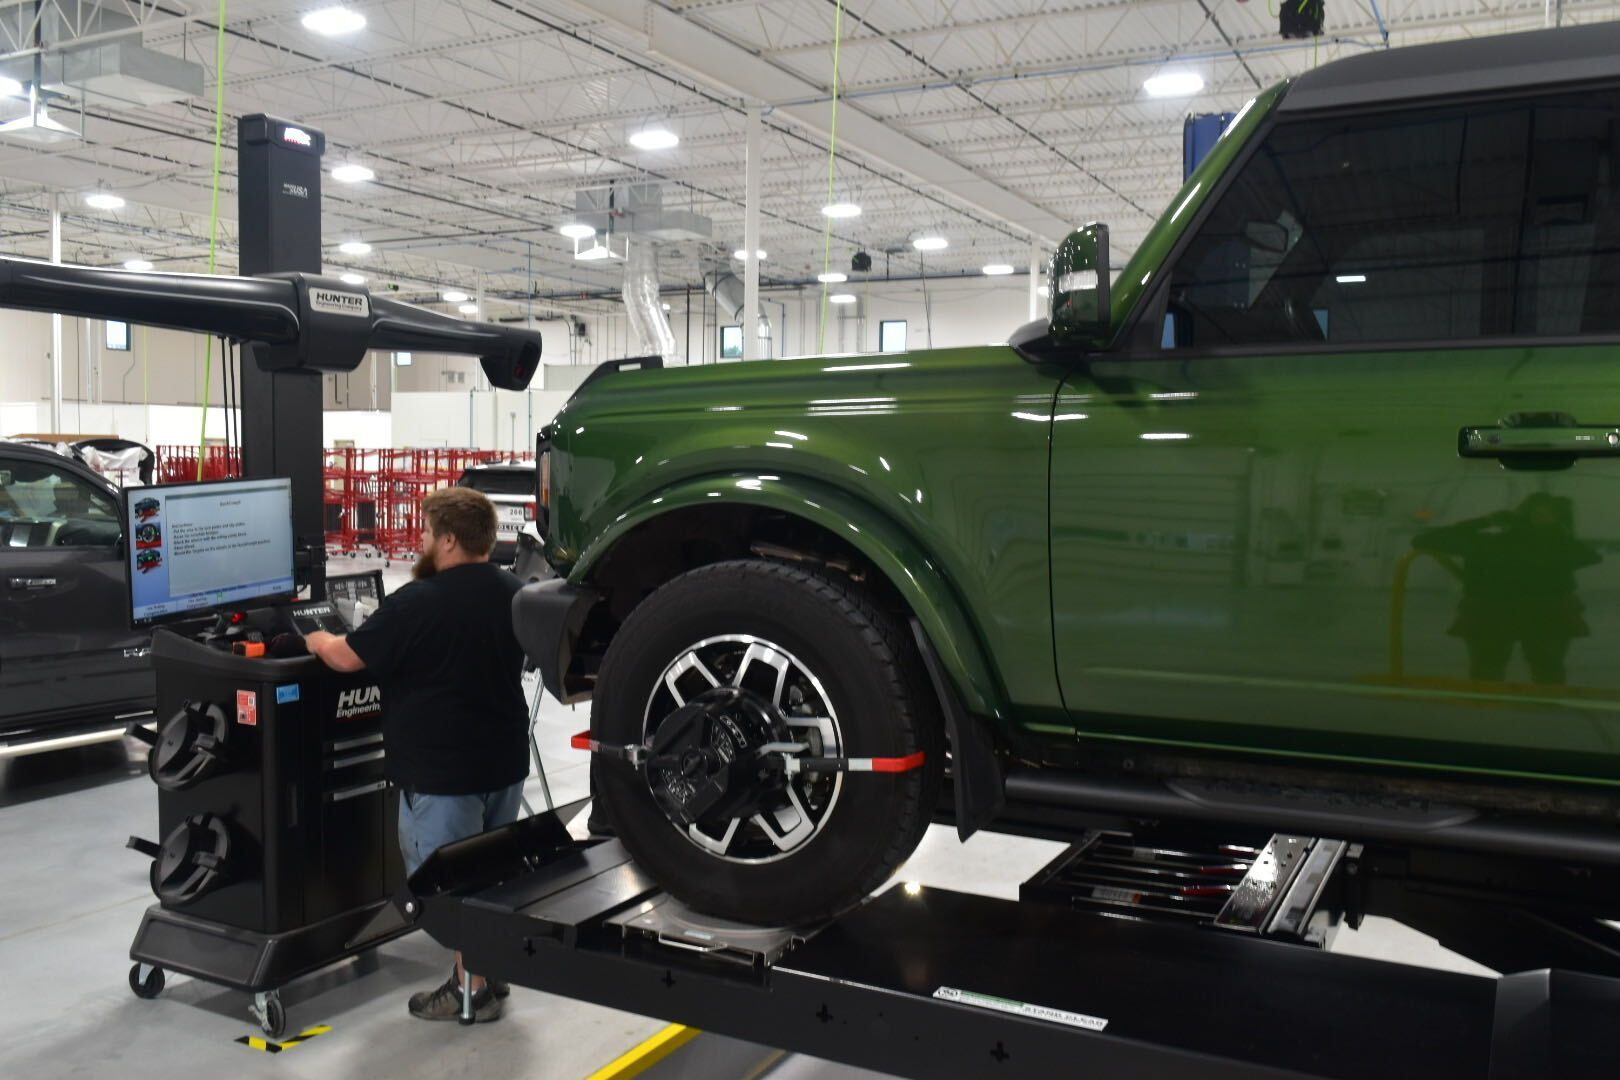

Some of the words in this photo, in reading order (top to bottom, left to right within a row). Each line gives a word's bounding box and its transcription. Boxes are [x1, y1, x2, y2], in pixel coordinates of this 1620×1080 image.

[316, 292, 362, 306] HUNTER
[292, 606, 331, 617] HUNTER
[337, 685, 381, 708] HUN
[336, 703, 381, 719] Engineerin
